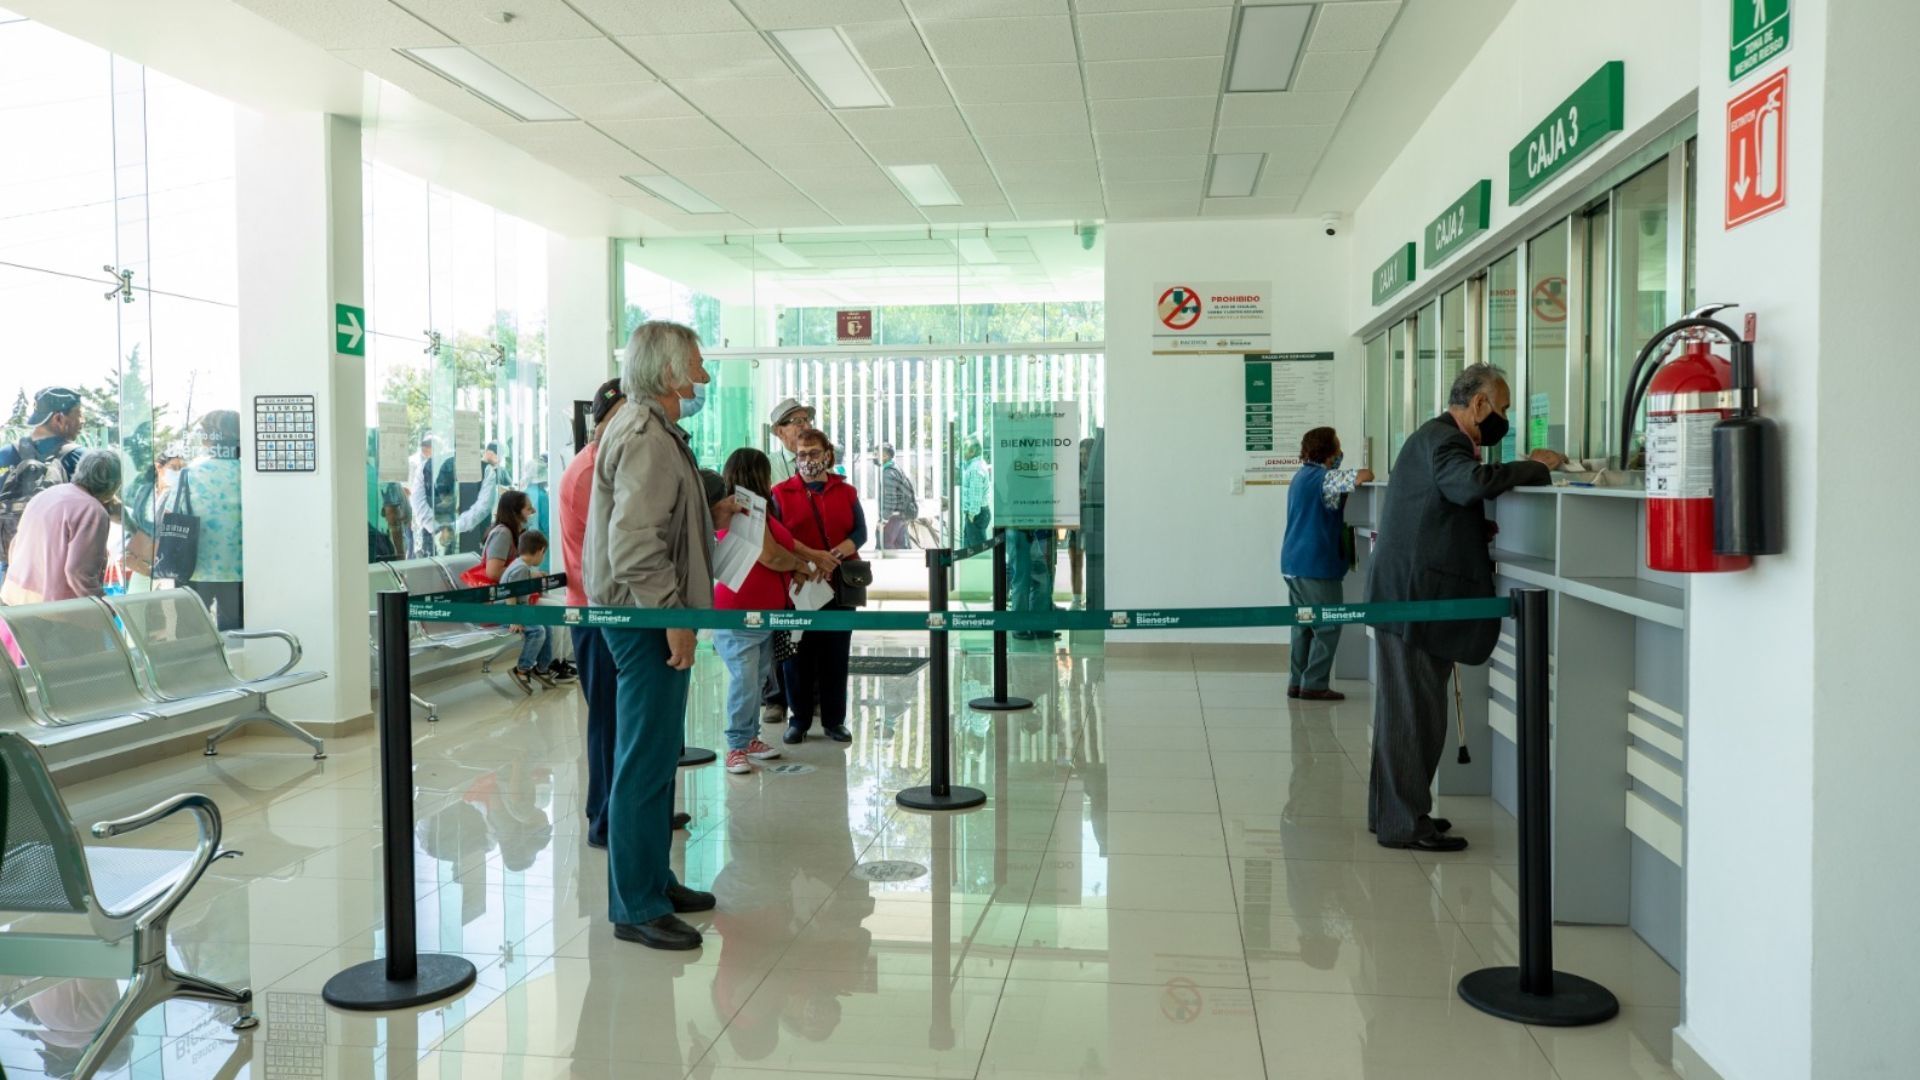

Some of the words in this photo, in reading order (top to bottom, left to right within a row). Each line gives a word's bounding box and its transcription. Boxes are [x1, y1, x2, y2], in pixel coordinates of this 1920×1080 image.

[1527, 117, 1567, 179] CAJA
[1568, 105, 1579, 148] 3
[1435, 211, 1457, 251] CAJA
[1457, 204, 1465, 237] 2
[1379, 262, 1394, 294] CAJA
[1210, 295, 1261, 303] PROHIBIDO
[1000, 438, 1072, 449] BIENVENIDO
[410, 609, 451, 617] Bienestar
[1321, 611, 1365, 619] Bienestar
[770, 616, 812, 625] Bienestar
[953, 618, 995, 626] Bienestar
[1136, 616, 1179, 624] Bienestar
